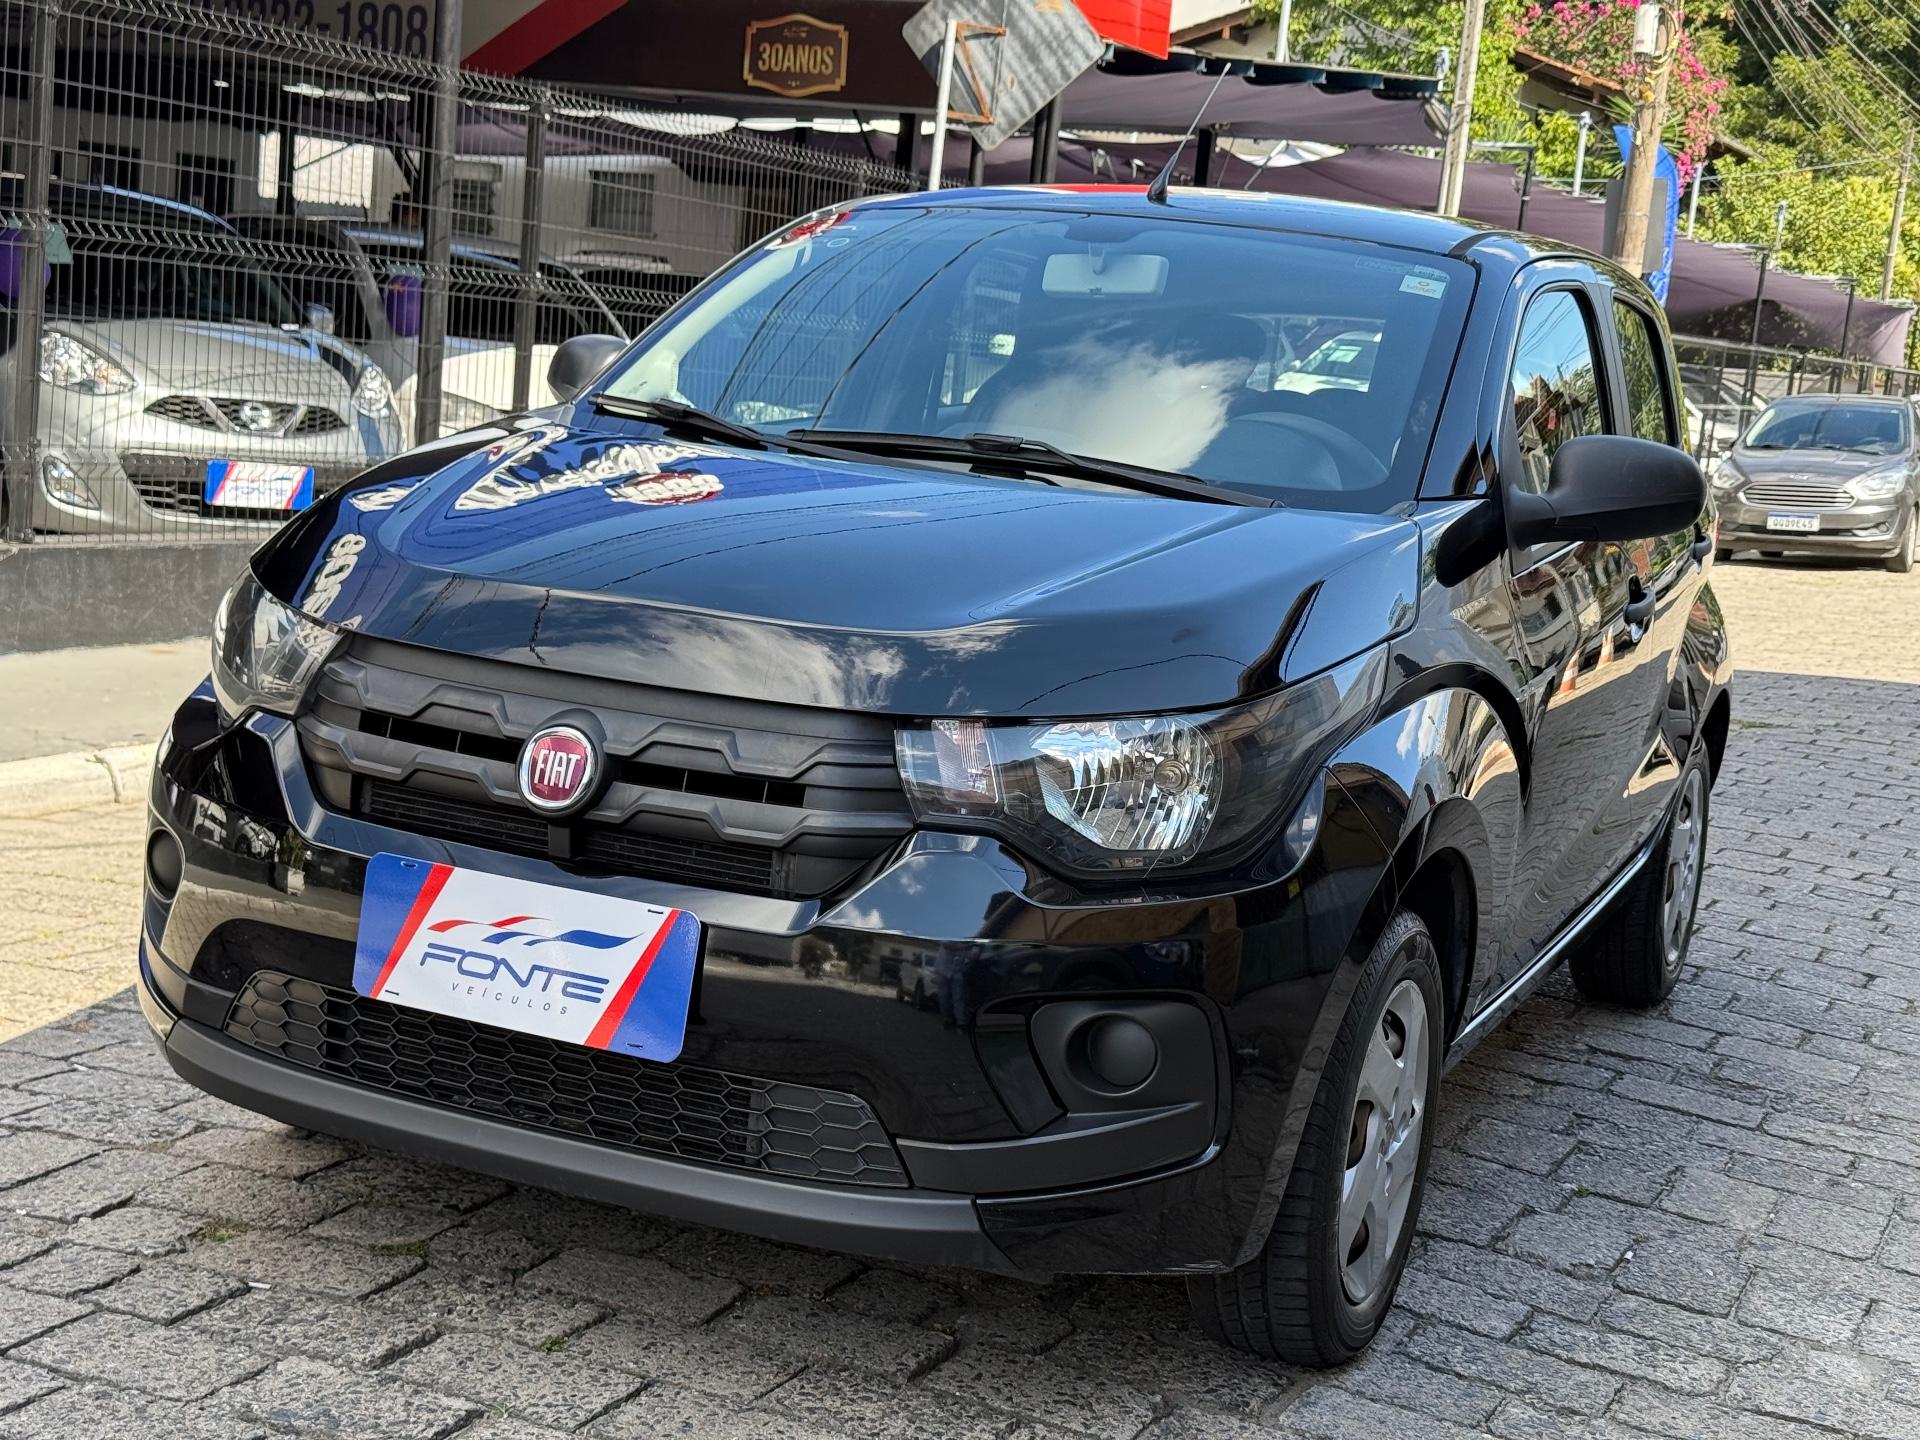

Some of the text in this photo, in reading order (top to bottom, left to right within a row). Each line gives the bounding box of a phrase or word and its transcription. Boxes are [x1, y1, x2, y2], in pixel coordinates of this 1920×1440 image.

[533, 748, 581, 790] FIAT
[419, 942, 610, 1004] FONTE
[451, 981, 569, 1016] VEÍCULOS
